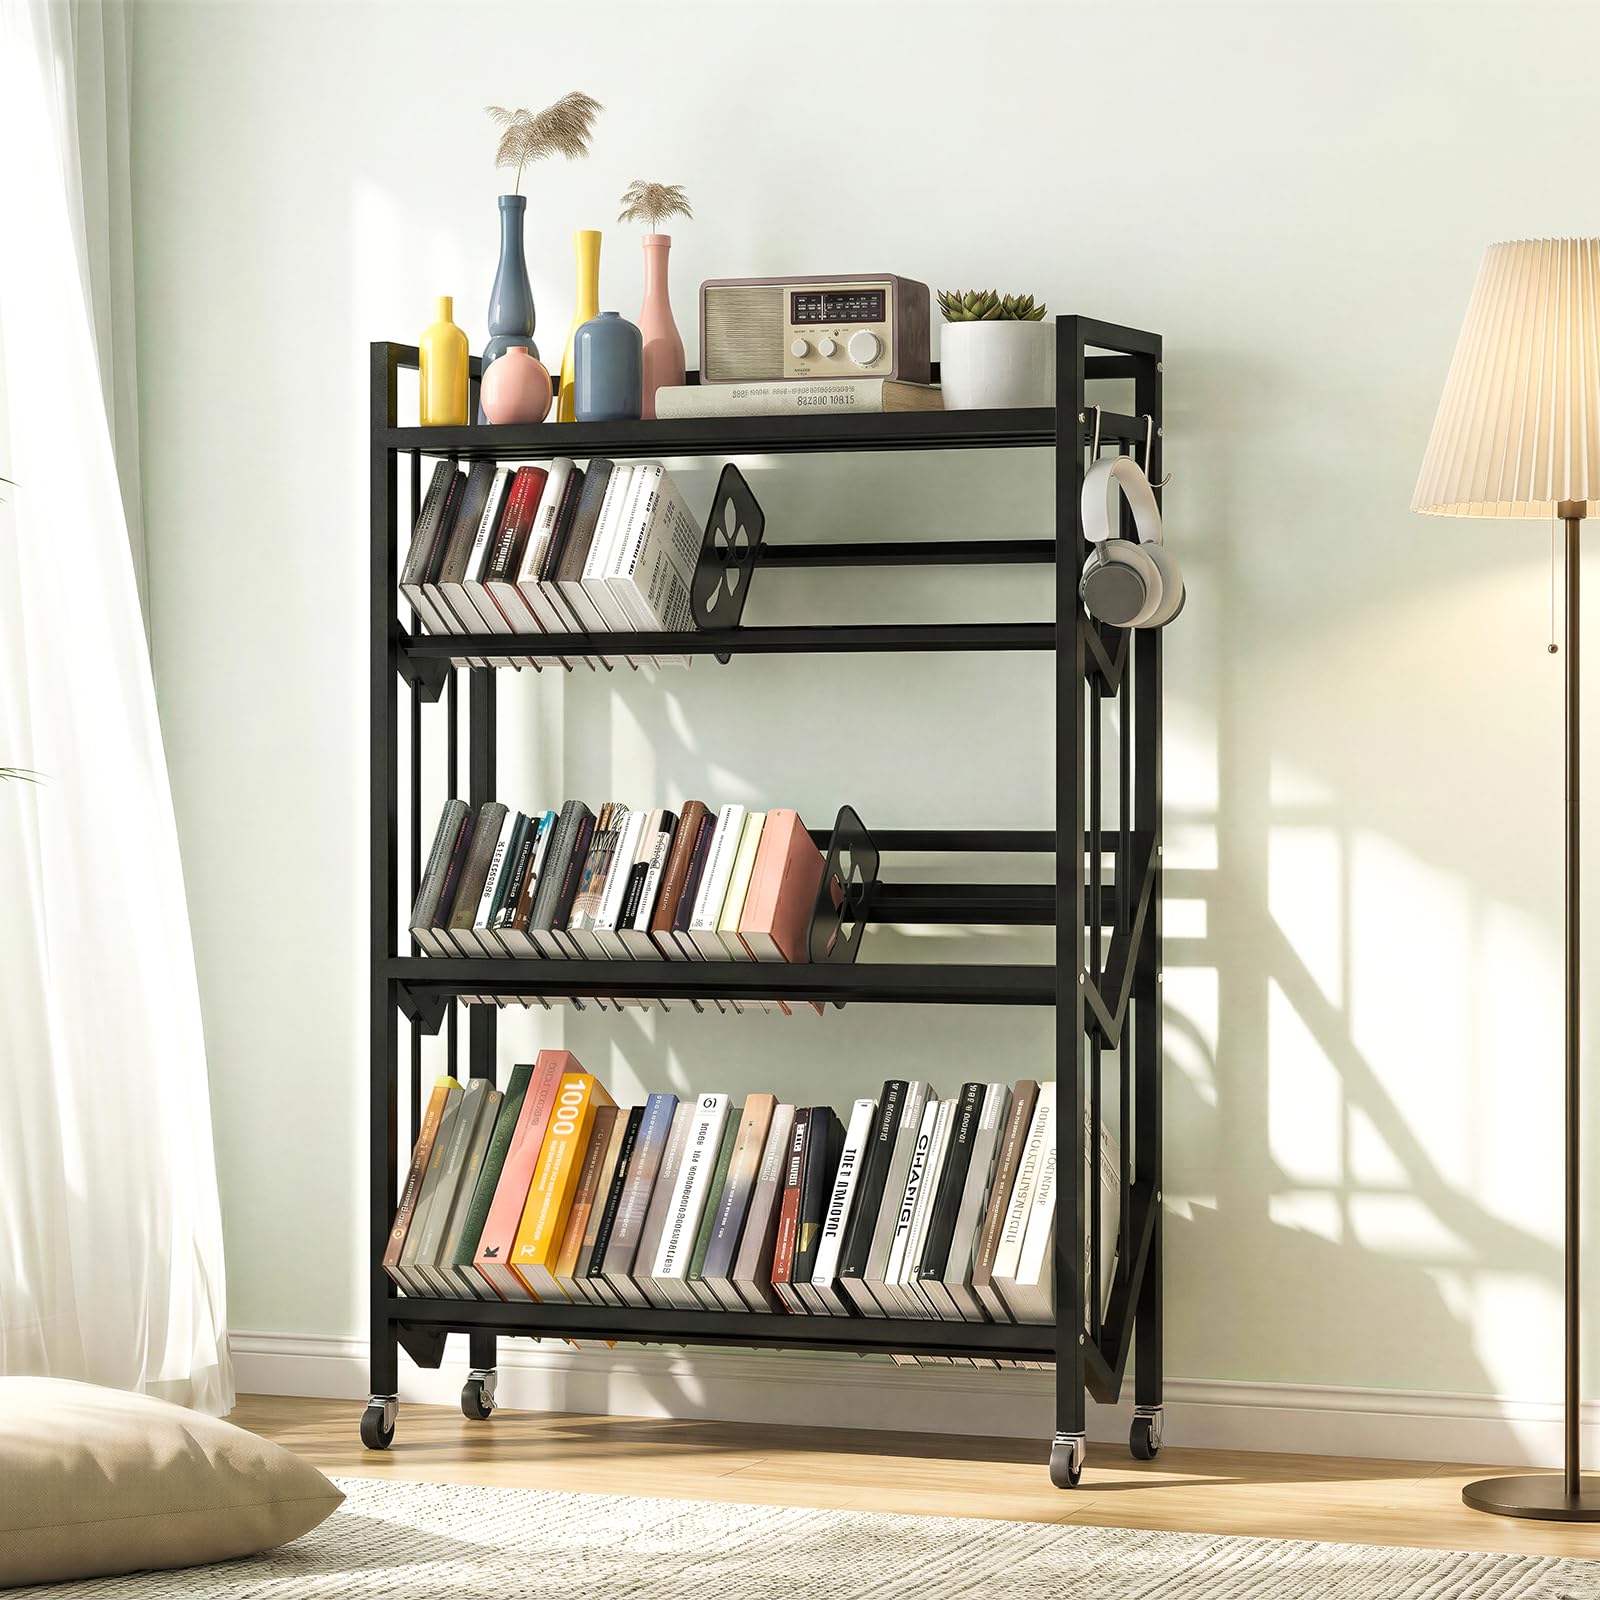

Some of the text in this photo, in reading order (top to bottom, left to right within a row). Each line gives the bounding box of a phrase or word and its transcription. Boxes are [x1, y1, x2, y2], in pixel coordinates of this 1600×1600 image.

[552, 1079, 587, 1136] 1000
[483, 1246, 500, 1258] K
[521, 1244, 537, 1257] R
